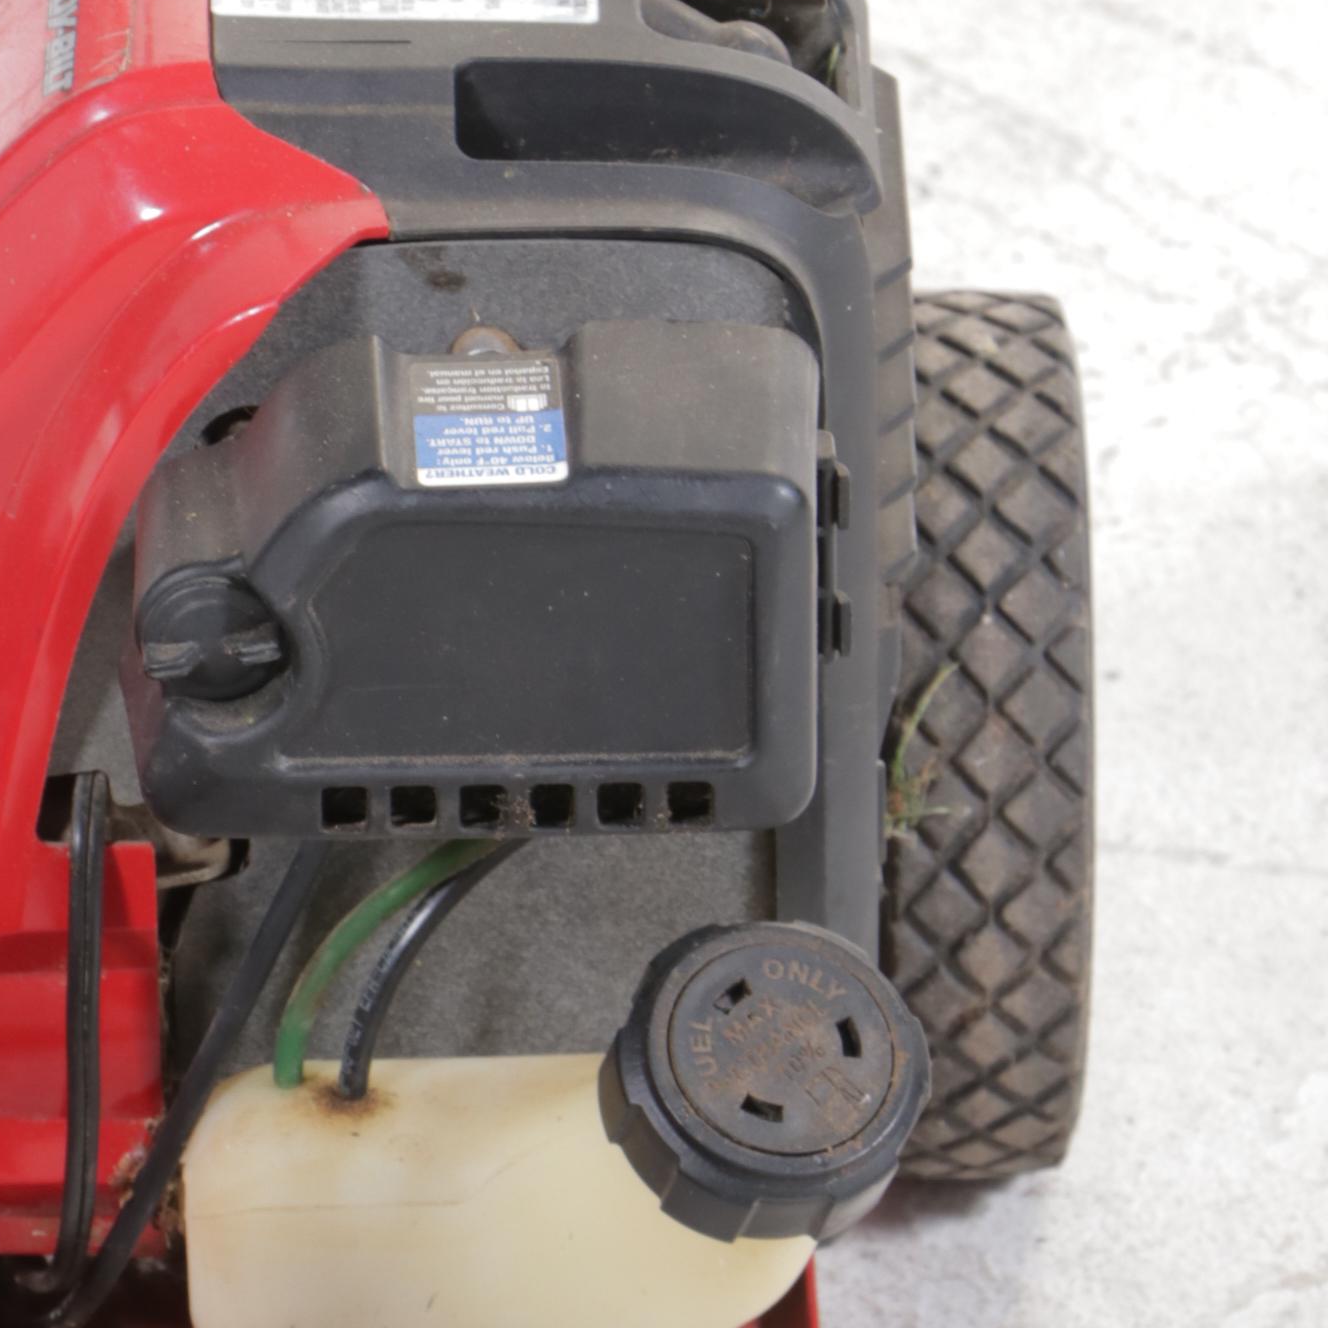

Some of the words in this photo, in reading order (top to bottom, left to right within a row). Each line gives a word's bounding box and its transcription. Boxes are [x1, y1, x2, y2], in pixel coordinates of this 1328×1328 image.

[515, 415, 534, 423] UP
[443, 427, 478, 435] lever
[482, 426, 504, 434] red
[494, 435, 535, 444] DOWN
[437, 447, 471, 455] lever
[476, 446, 498, 455] red
[503, 445, 537, 454] Push
[512, 455, 555, 463] Below
[426, 466, 510, 479] WEATHER?
[515, 465, 556, 475] COLD
[763, 959, 847, 1000] ONLY
